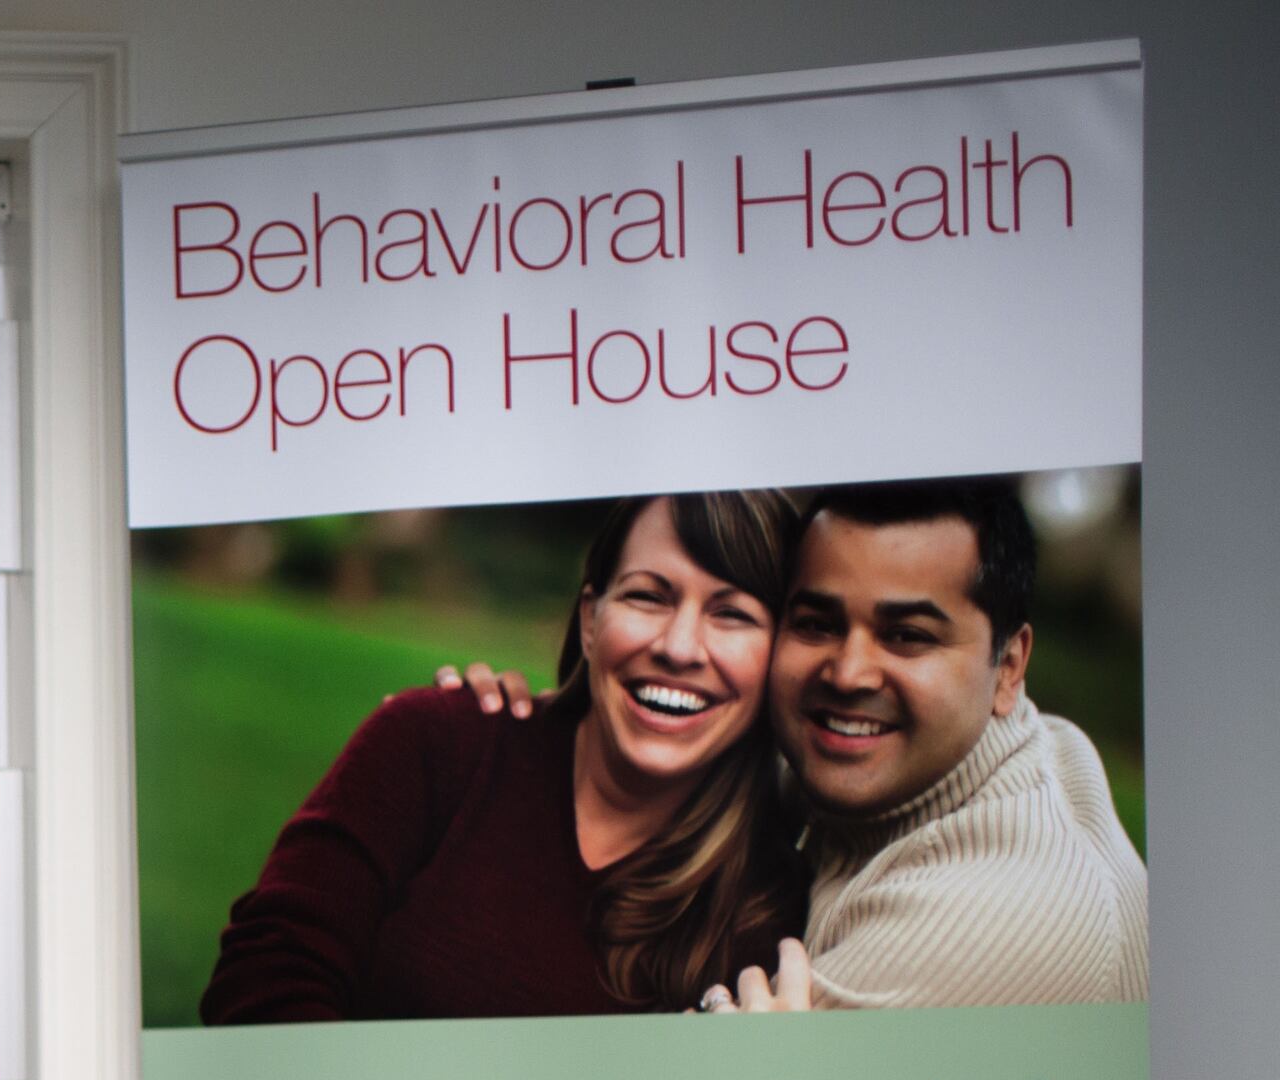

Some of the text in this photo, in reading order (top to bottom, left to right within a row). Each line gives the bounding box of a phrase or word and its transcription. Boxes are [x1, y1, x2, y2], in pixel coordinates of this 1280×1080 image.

[172, 131, 1074, 299] Behavioral Health
[172, 308, 850, 452] Open House
